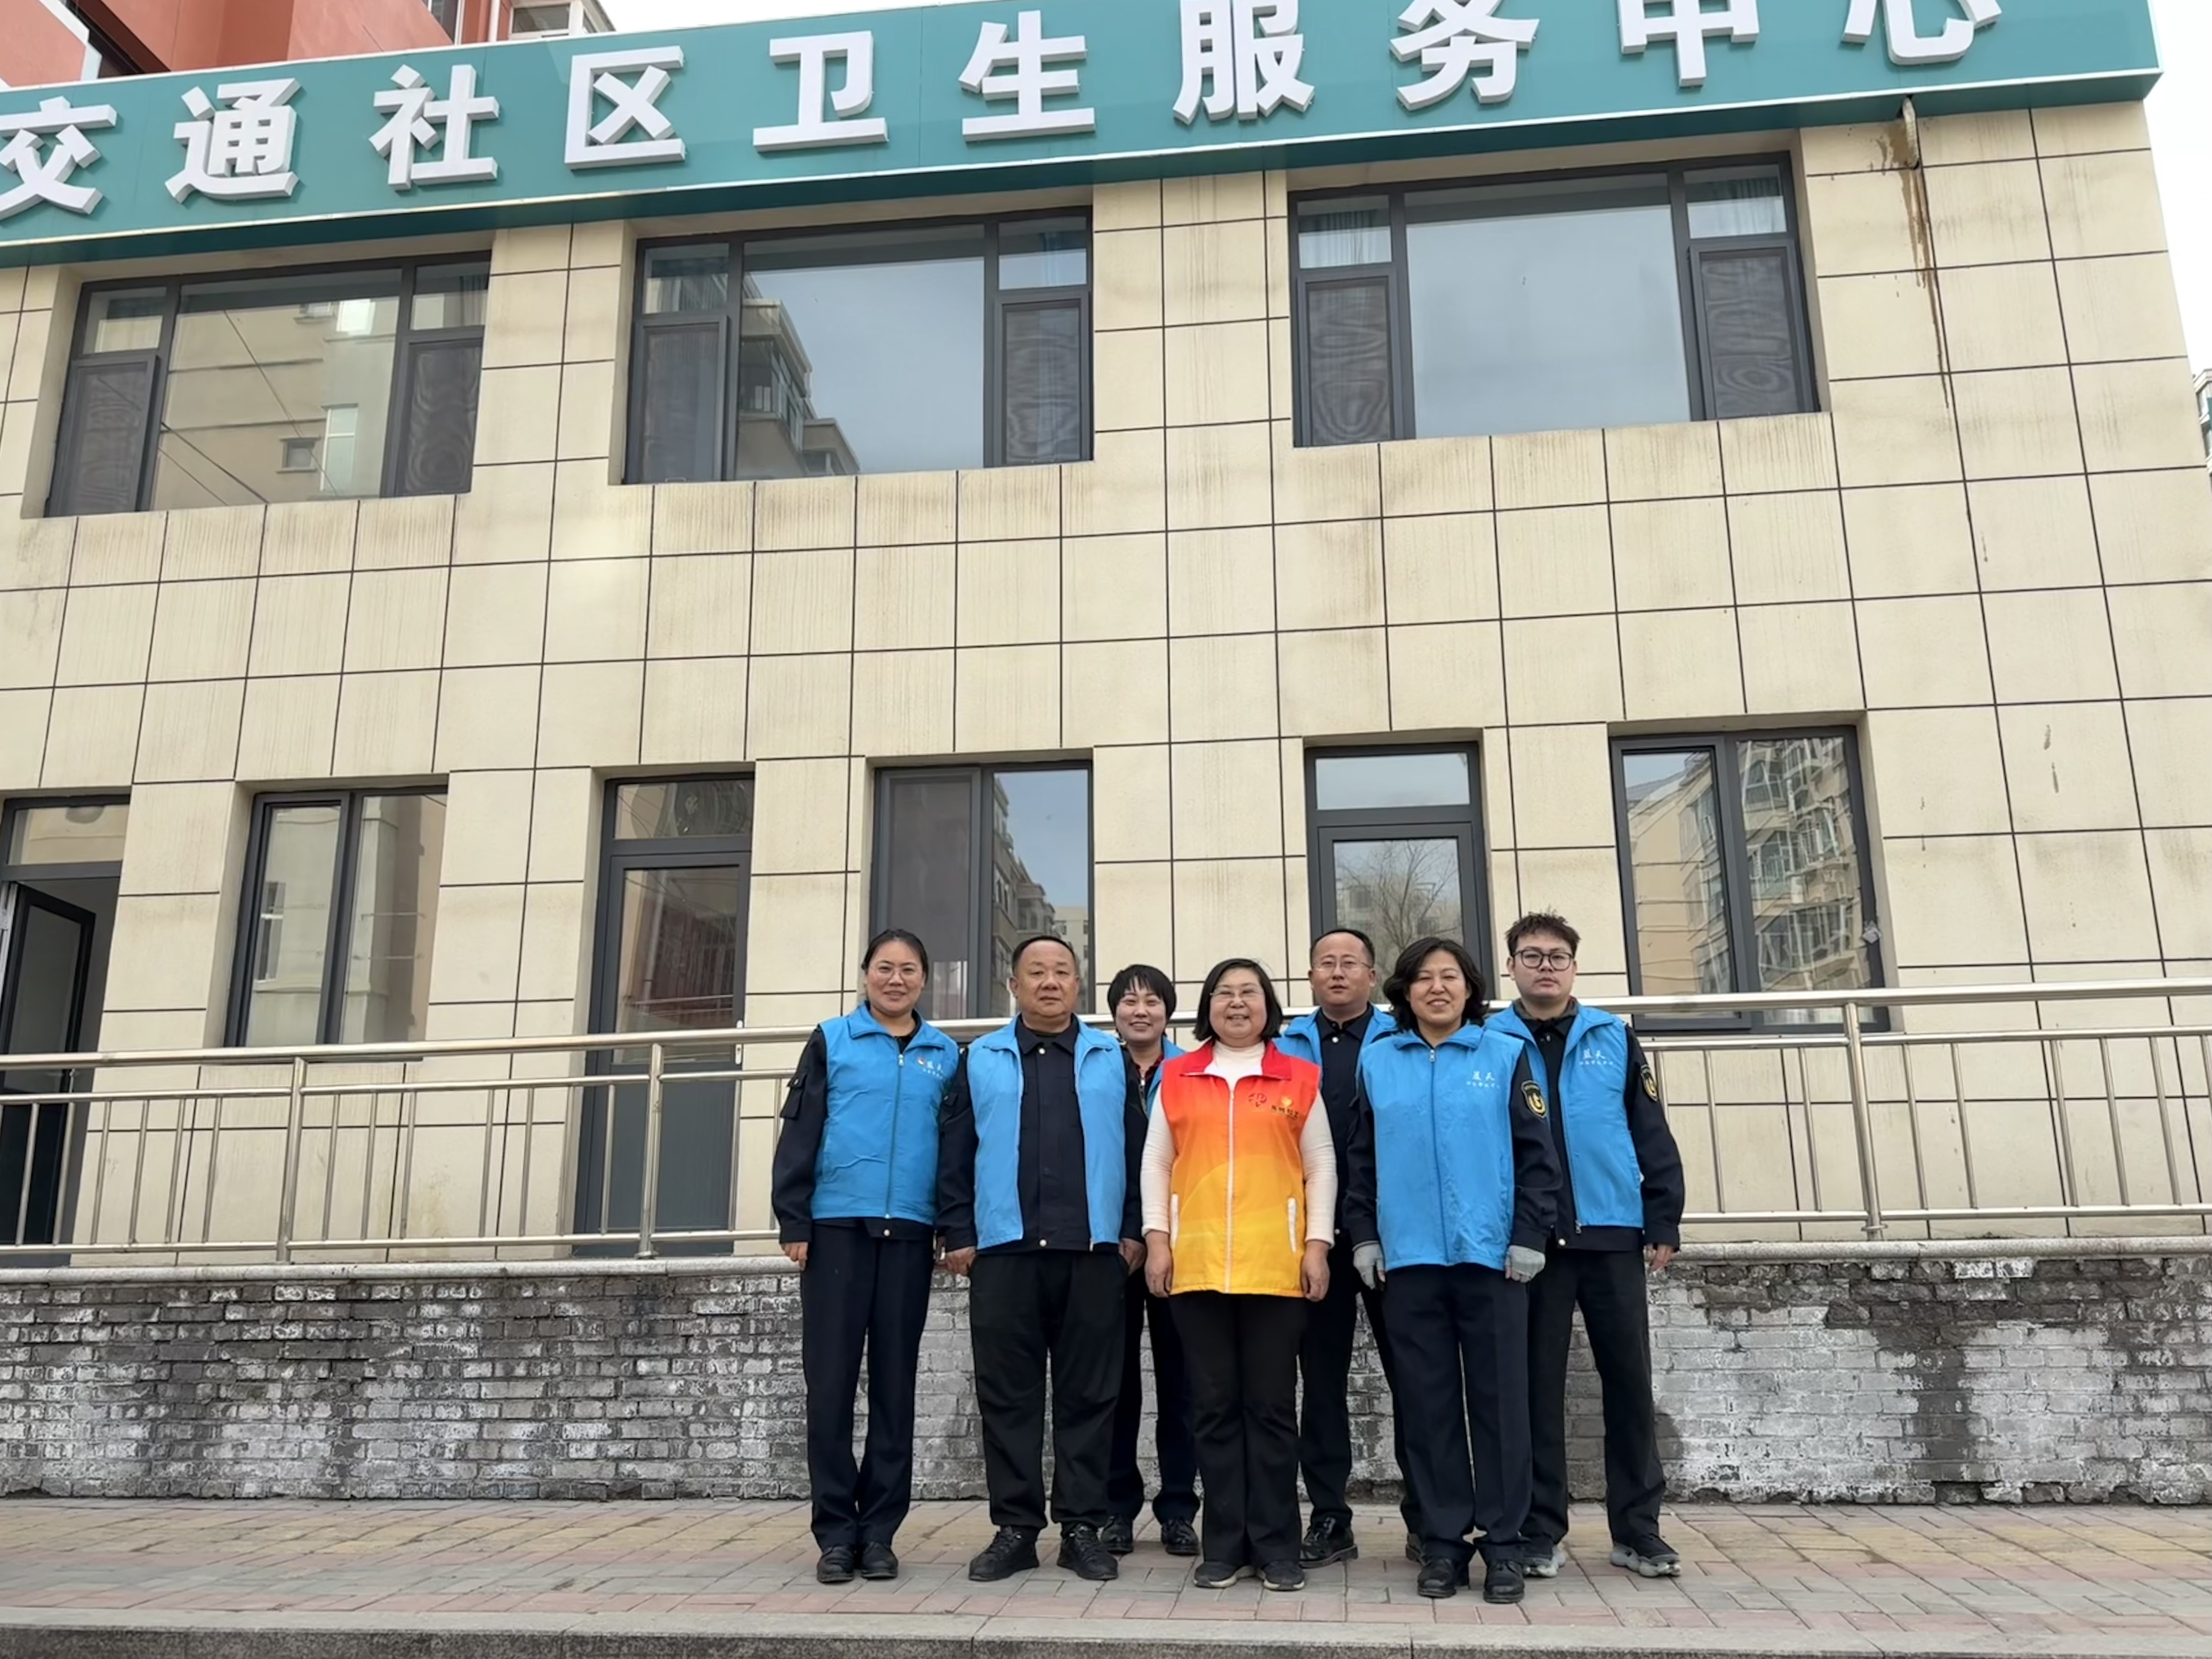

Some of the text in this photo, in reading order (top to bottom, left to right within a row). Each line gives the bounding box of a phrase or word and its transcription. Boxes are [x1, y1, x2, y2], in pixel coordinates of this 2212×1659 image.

[0, 0, 2002, 220] 交通社区卫生服务中心
